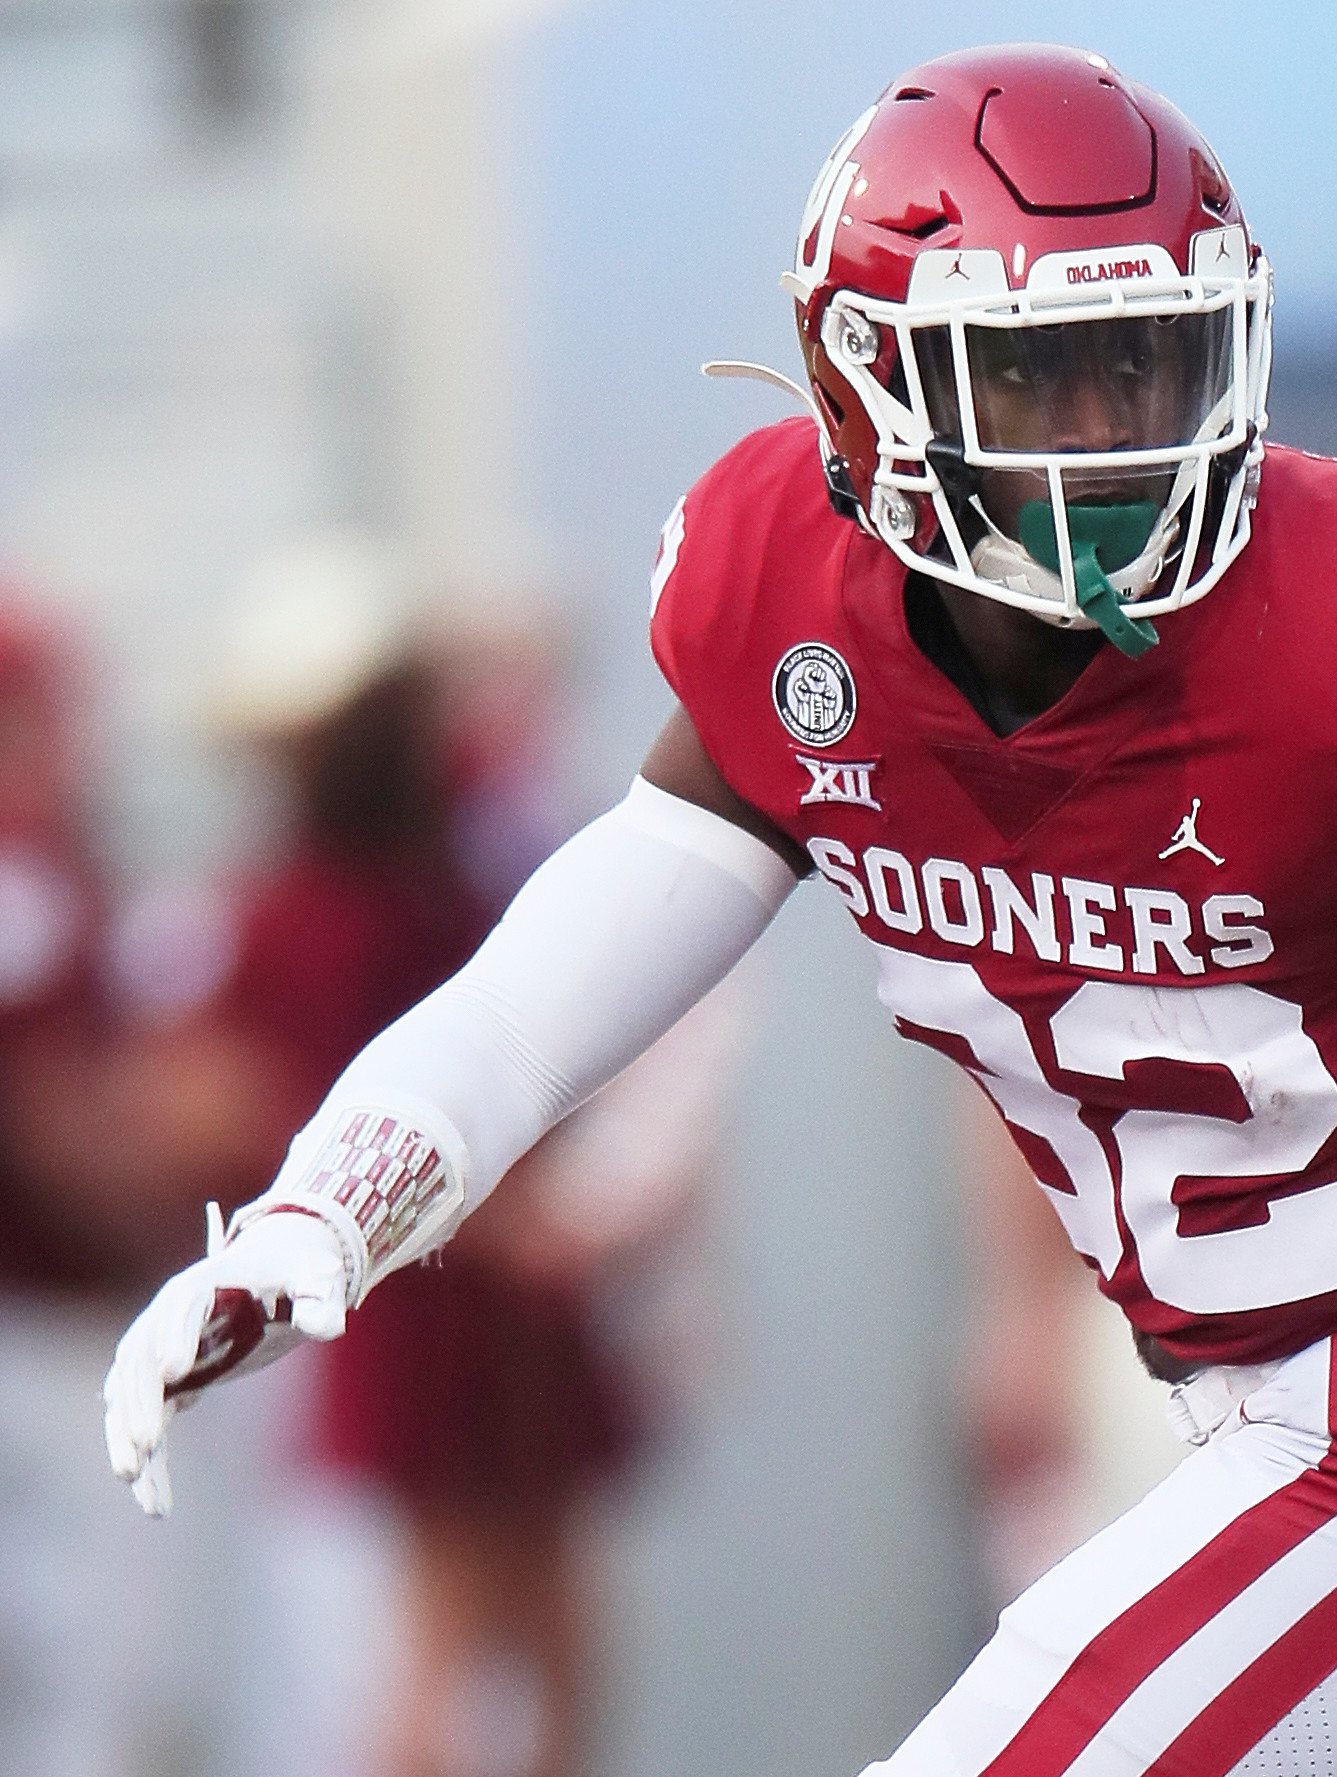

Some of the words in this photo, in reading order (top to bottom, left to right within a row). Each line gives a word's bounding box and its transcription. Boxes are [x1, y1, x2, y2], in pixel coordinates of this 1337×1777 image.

[1066, 258, 1153, 284] OKLAHOMA
[795, 754, 882, 812] XII
[806, 836, 1275, 976] SOONERS
